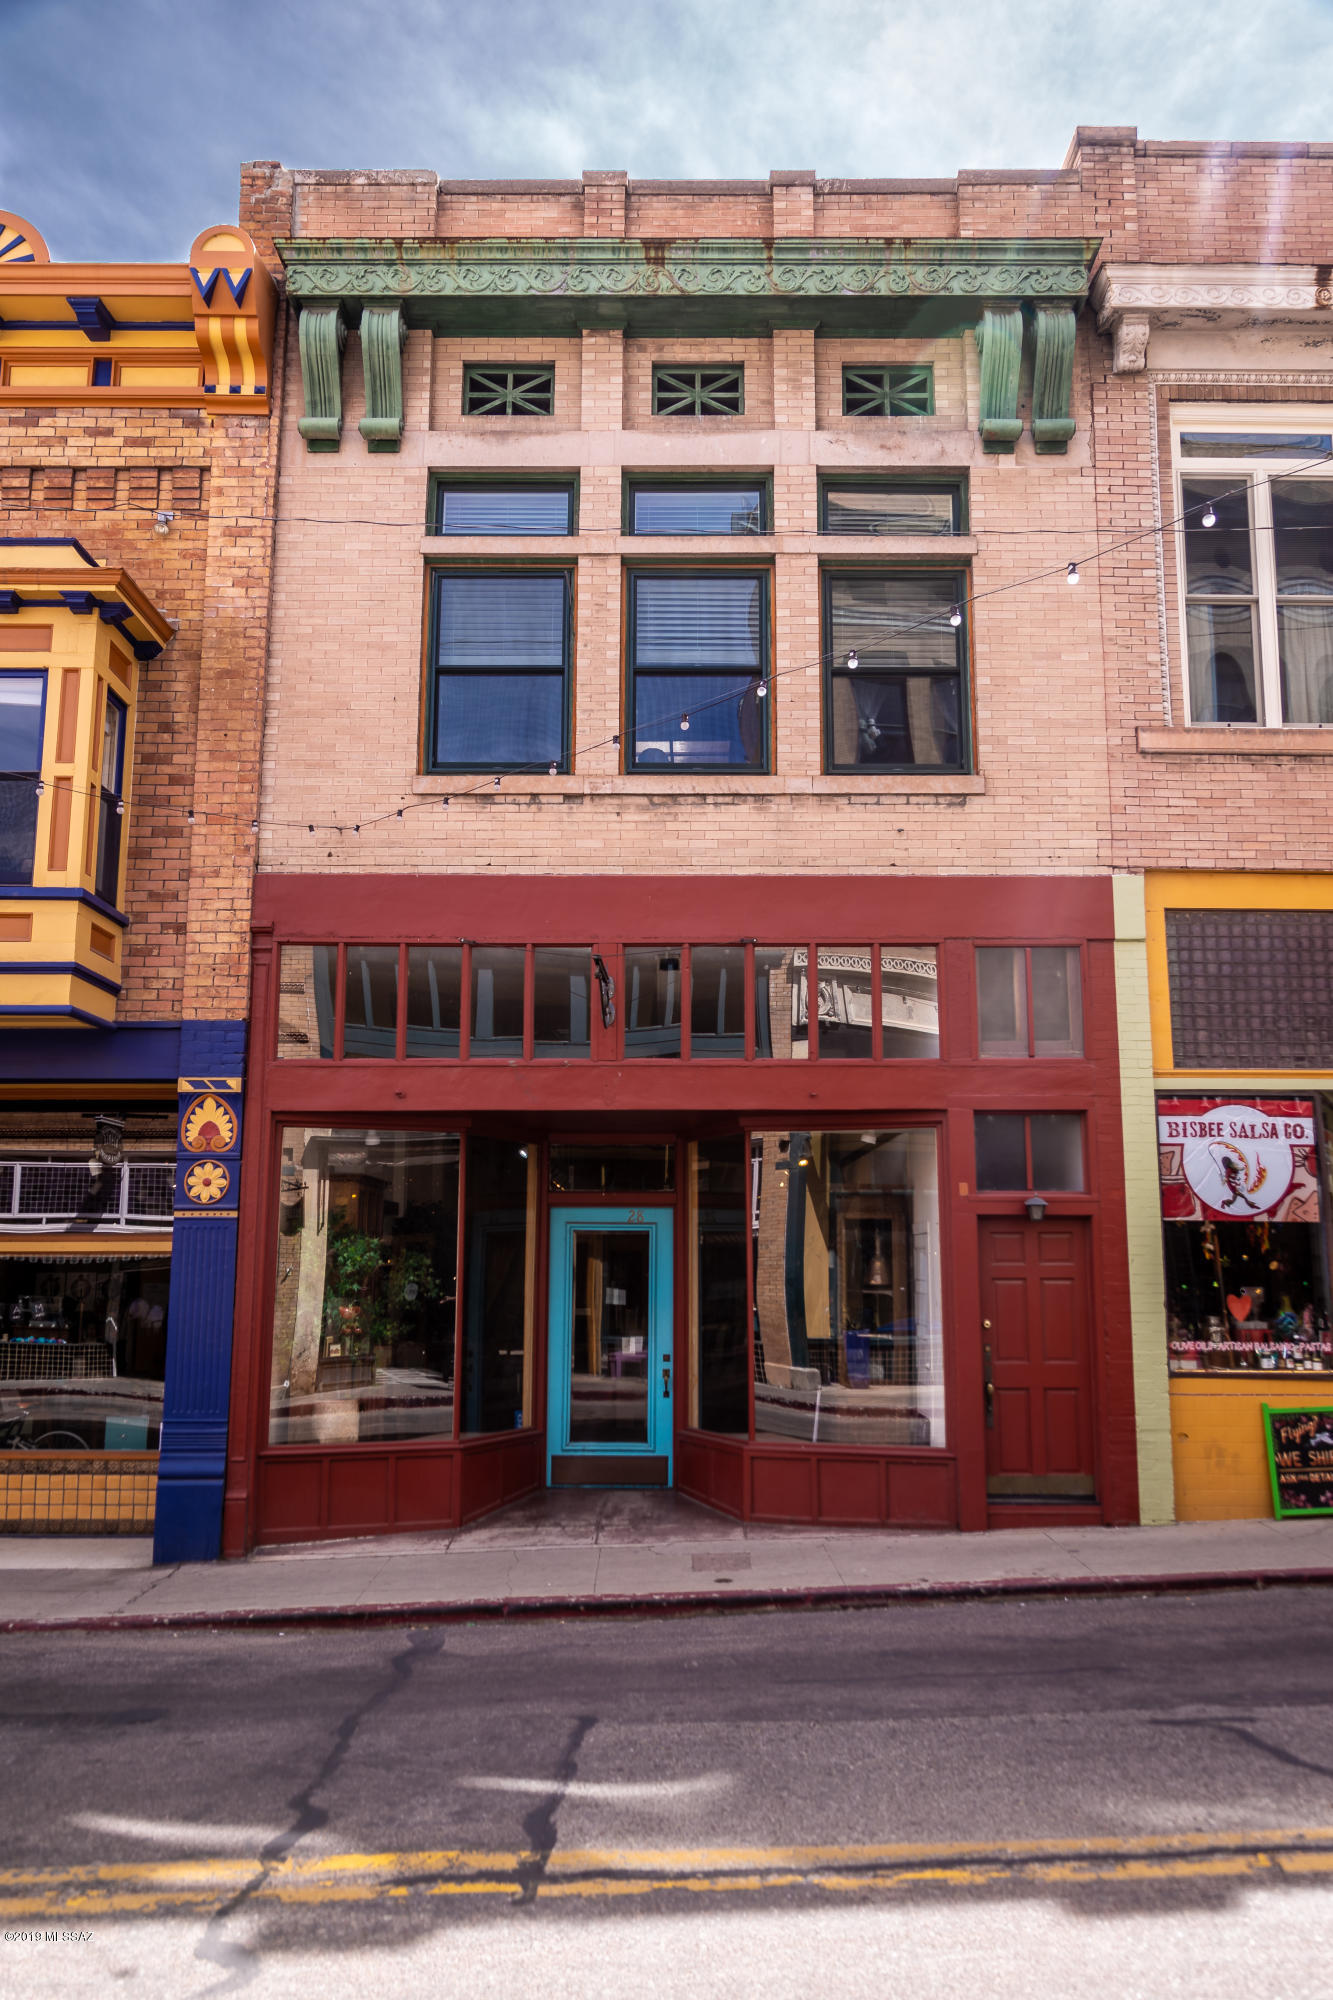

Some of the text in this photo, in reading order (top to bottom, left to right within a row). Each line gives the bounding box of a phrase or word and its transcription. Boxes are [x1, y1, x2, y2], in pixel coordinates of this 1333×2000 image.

[1166, 1121, 1309, 1139] BISBEE SALSA CO.
[627, 1209, 645, 1224] 28
[1171, 1341, 1195, 1351] OLIVE
[1217, 1341, 1253, 1351] ARTISAN
[1299, 1342, 1332, 1352] PASTAS
[1275, 1450, 1303, 1467] WE
